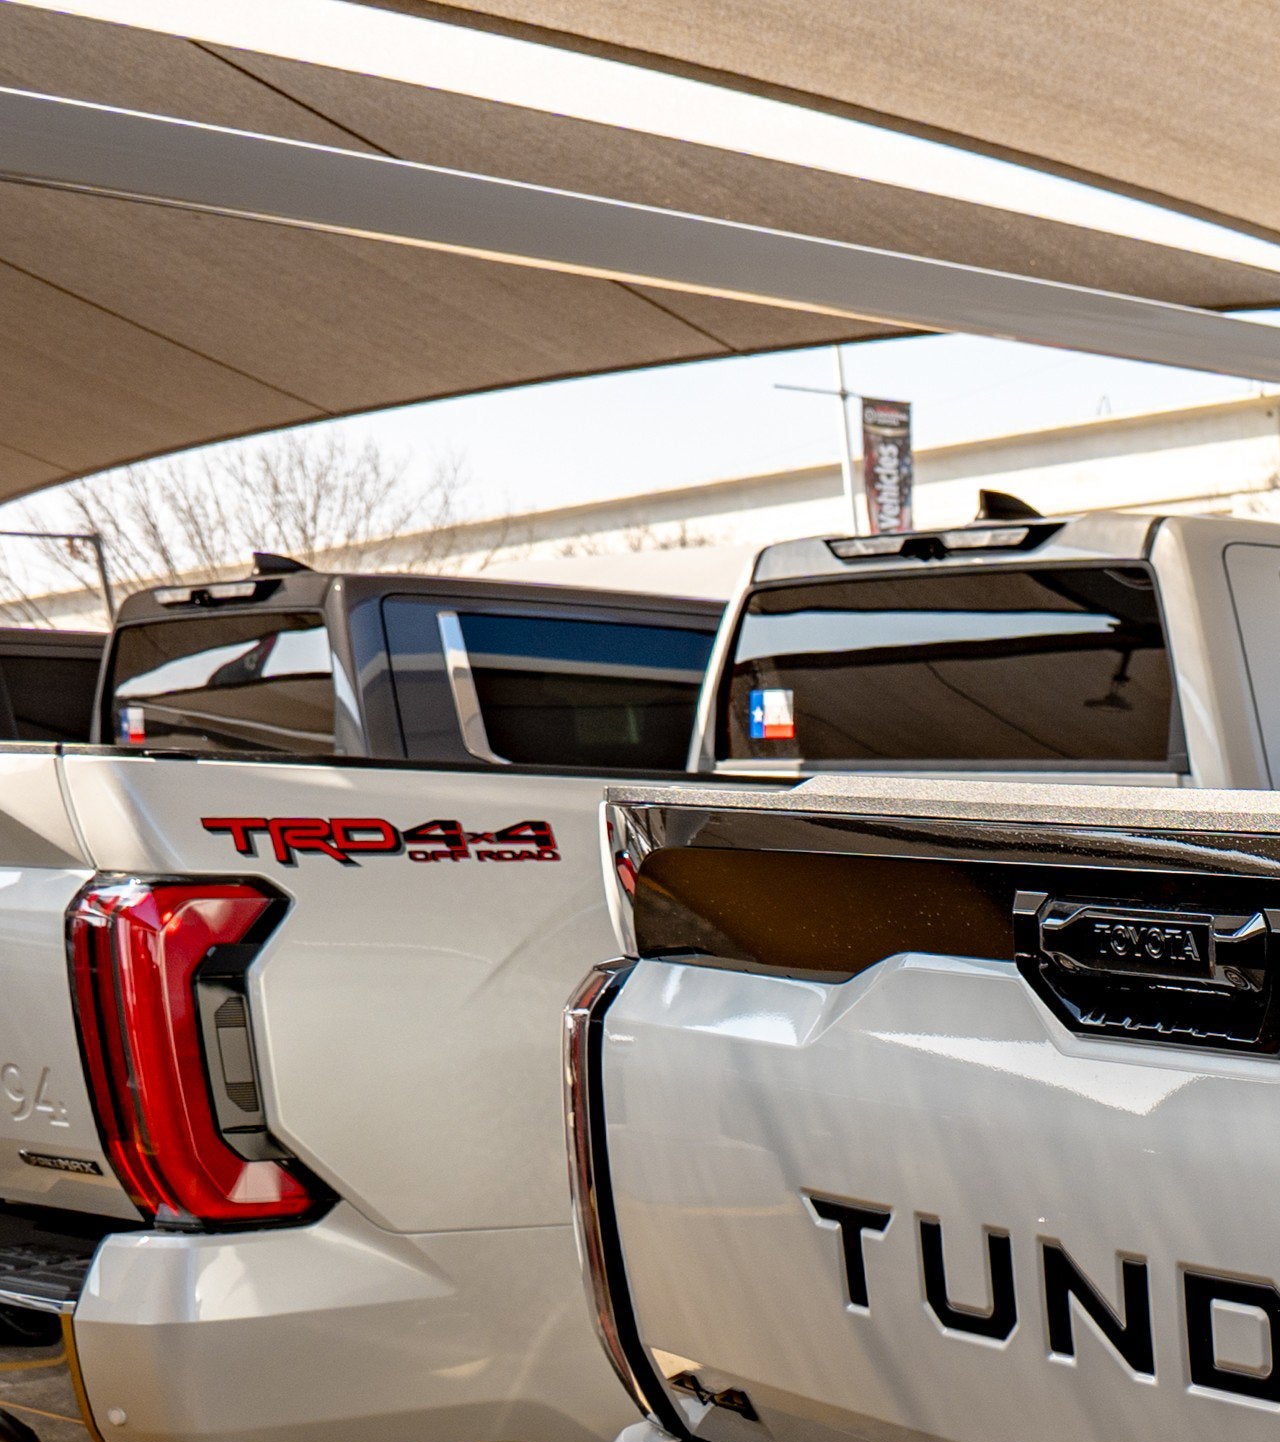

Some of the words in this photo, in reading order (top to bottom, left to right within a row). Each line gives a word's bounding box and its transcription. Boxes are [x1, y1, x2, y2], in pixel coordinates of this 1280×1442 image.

[201, 818, 405, 867] TRD
[408, 850, 469, 862] OFF
[477, 851, 561, 863] ROAD
[1094, 923, 1200, 962] TOYOTA
